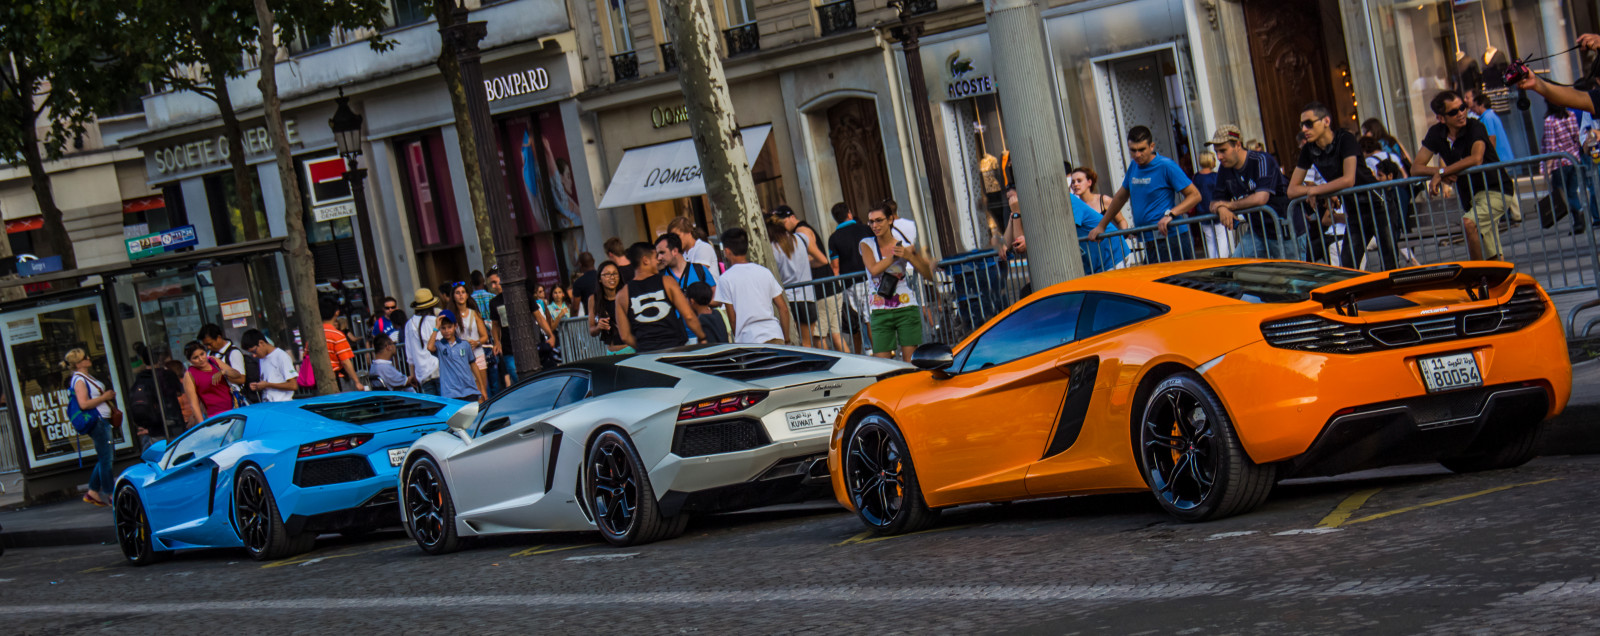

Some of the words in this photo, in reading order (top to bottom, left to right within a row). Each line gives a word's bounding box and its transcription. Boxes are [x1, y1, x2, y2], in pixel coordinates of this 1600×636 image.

[484, 67, 549, 101] BOMPARD
[948, 76, 991, 98] ACOSTE
[154, 139, 215, 173] SOCIETE
[630, 289, 672, 323] 5
[1431, 358, 1445, 370] 11
[1434, 367, 1478, 387] 80054
[30, 393, 49, 412] ICI,
[29, 407, 61, 429] C'EST
[790, 418, 814, 428] KUWAIT
